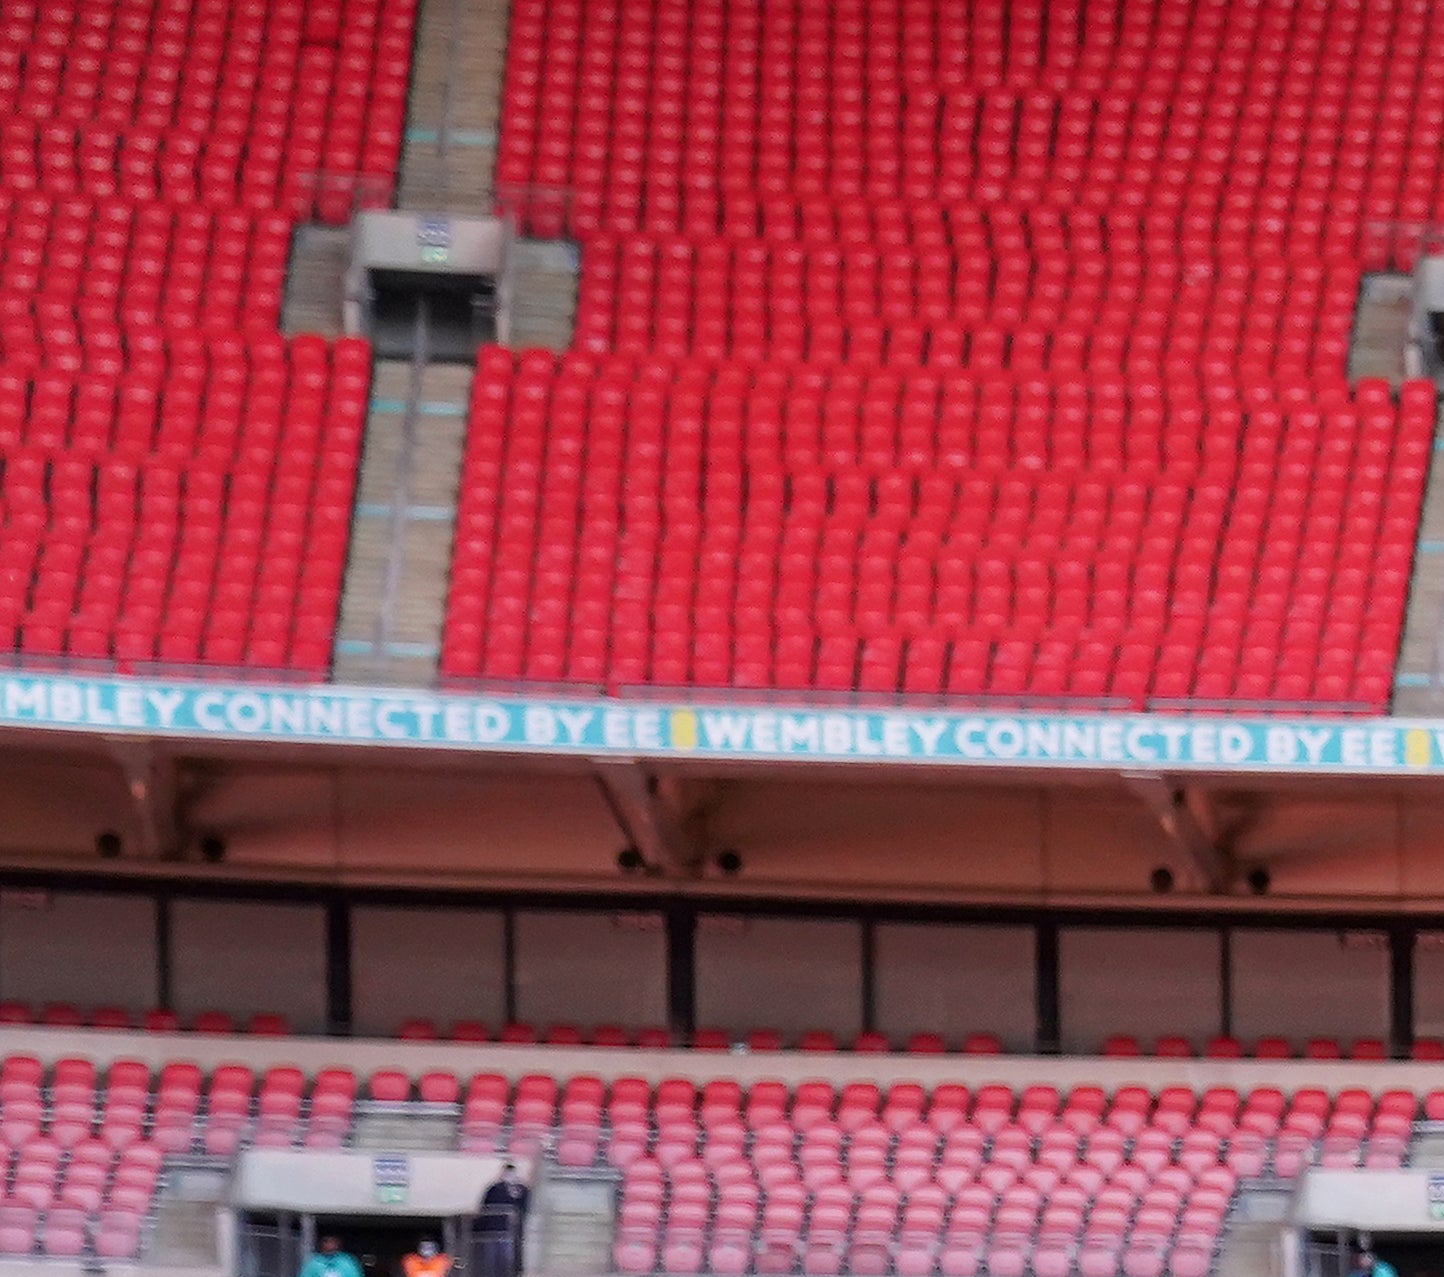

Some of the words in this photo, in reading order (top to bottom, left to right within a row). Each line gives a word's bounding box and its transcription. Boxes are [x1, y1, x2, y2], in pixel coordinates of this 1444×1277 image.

[0, 680, 184, 726] MBLEY
[194, 690, 509, 743] CONNECTED
[525, 706, 592, 744] BY
[603, 709, 660, 747] EE
[702, 712, 948, 758] WEMBLEY
[955, 720, 1254, 765] CONNECTED
[1266, 726, 1332, 766] BY
[1341, 727, 1398, 766] EE
